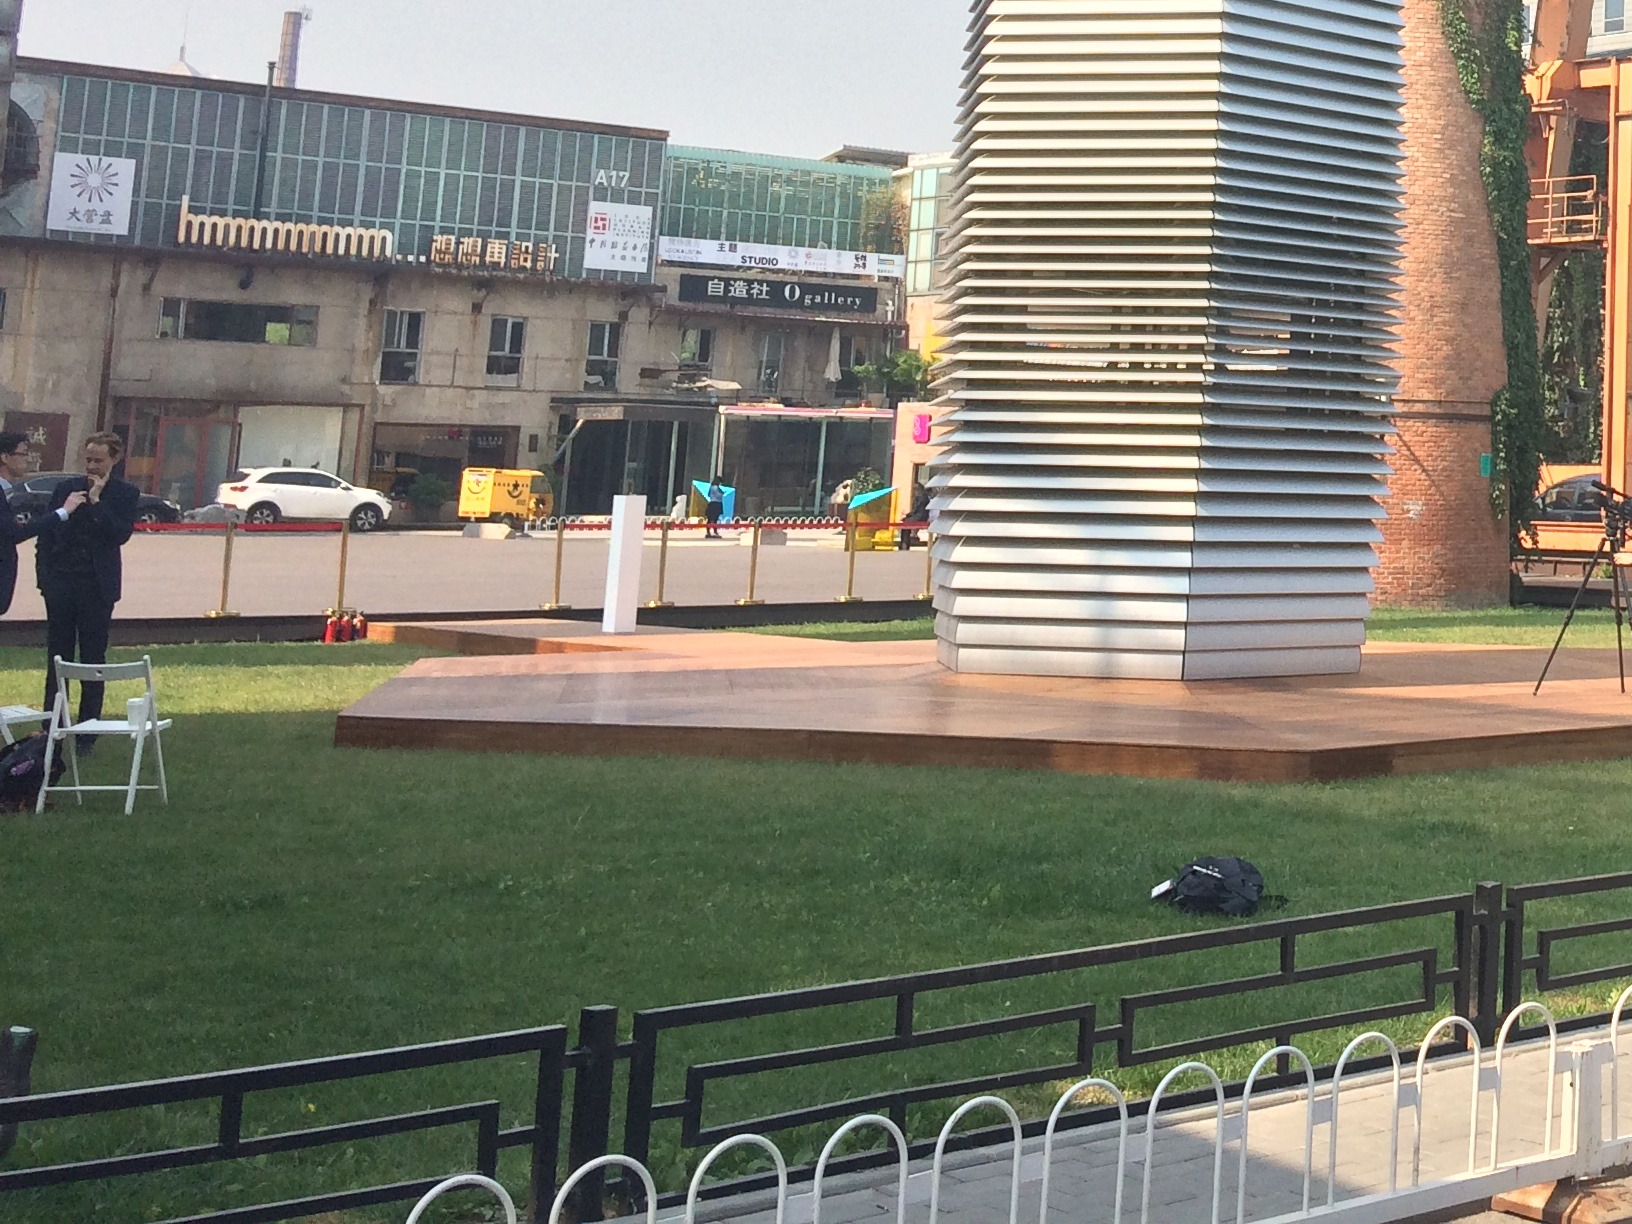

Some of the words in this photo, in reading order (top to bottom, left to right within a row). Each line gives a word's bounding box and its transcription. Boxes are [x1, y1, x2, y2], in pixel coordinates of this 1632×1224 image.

[594, 169, 630, 187] A17
[740, 255, 779, 267] STUDIO
[707, 279, 771, 299] 自造社
[803, 291, 863, 309] gallery
